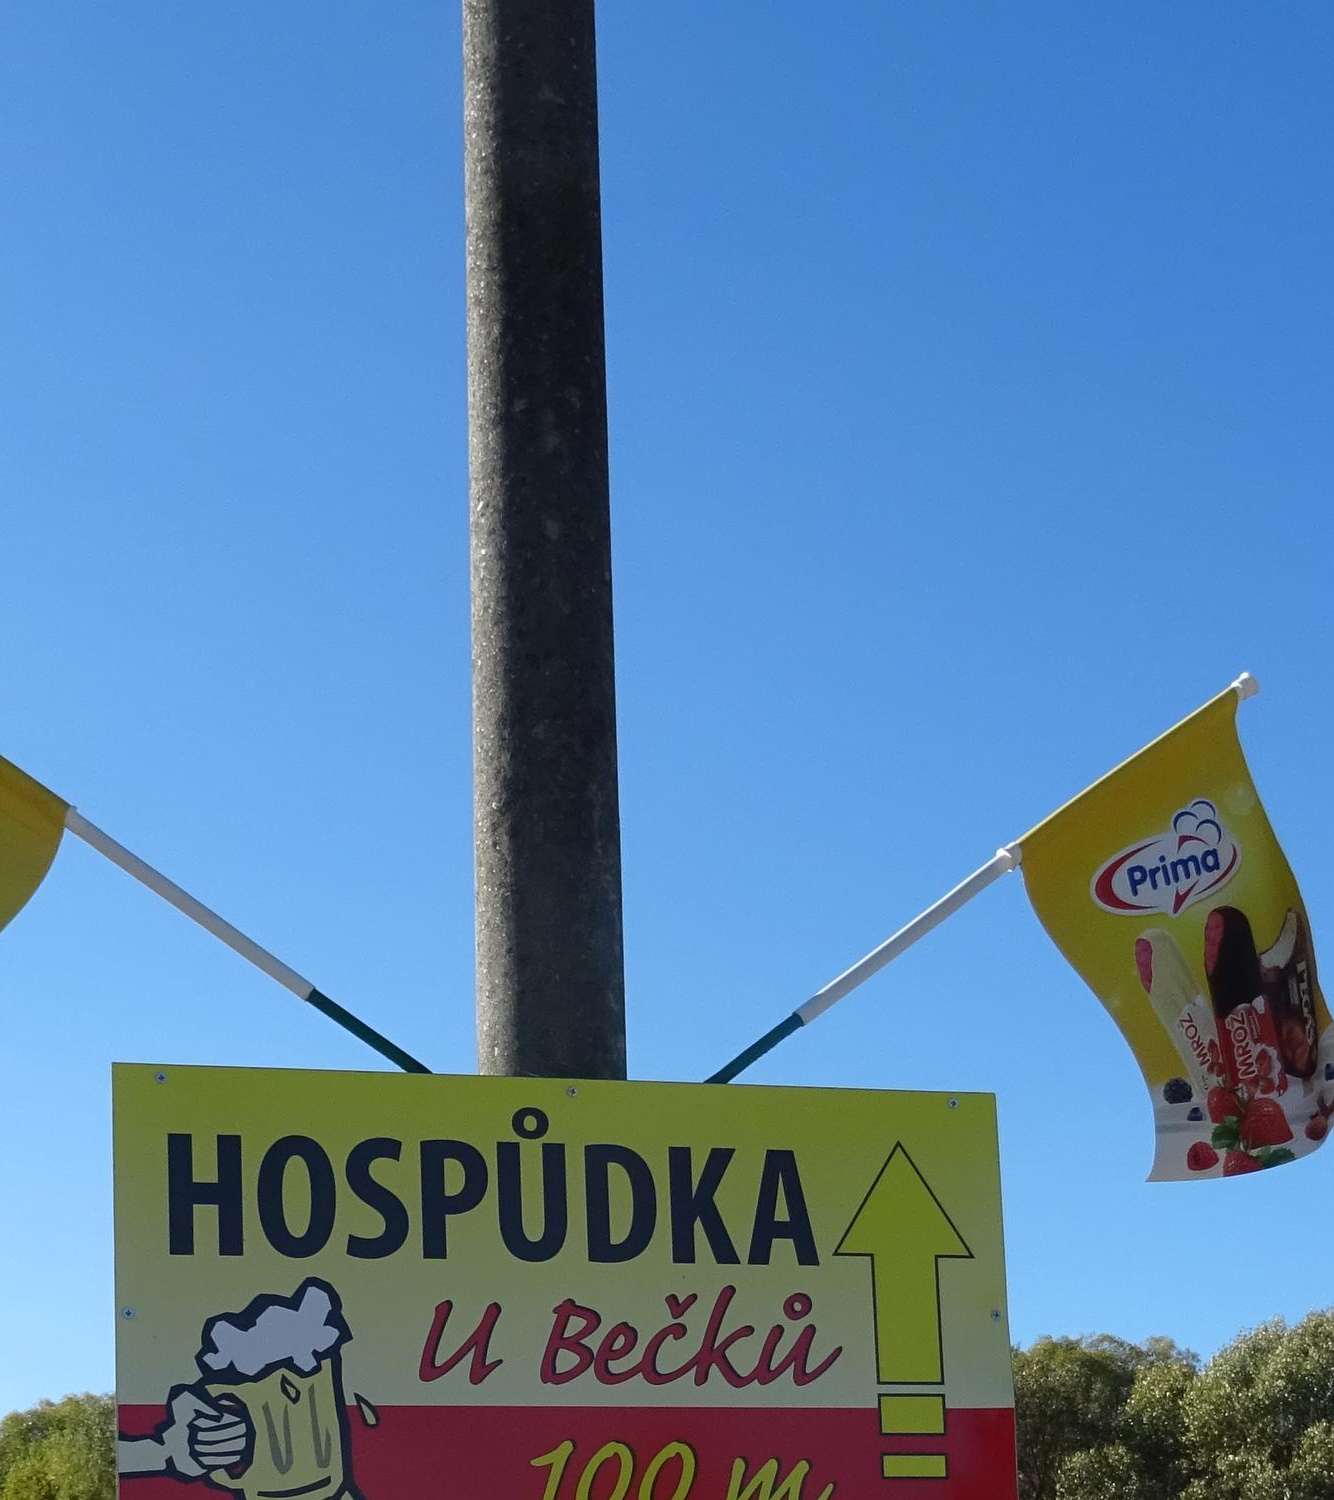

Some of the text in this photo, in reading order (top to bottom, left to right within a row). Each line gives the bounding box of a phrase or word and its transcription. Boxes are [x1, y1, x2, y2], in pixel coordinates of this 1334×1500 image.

[1127, 848, 1220, 897] Prima
[166, 1106, 819, 1267] HOSPŮDKA
[419, 1285, 843, 1387] U Bečků
